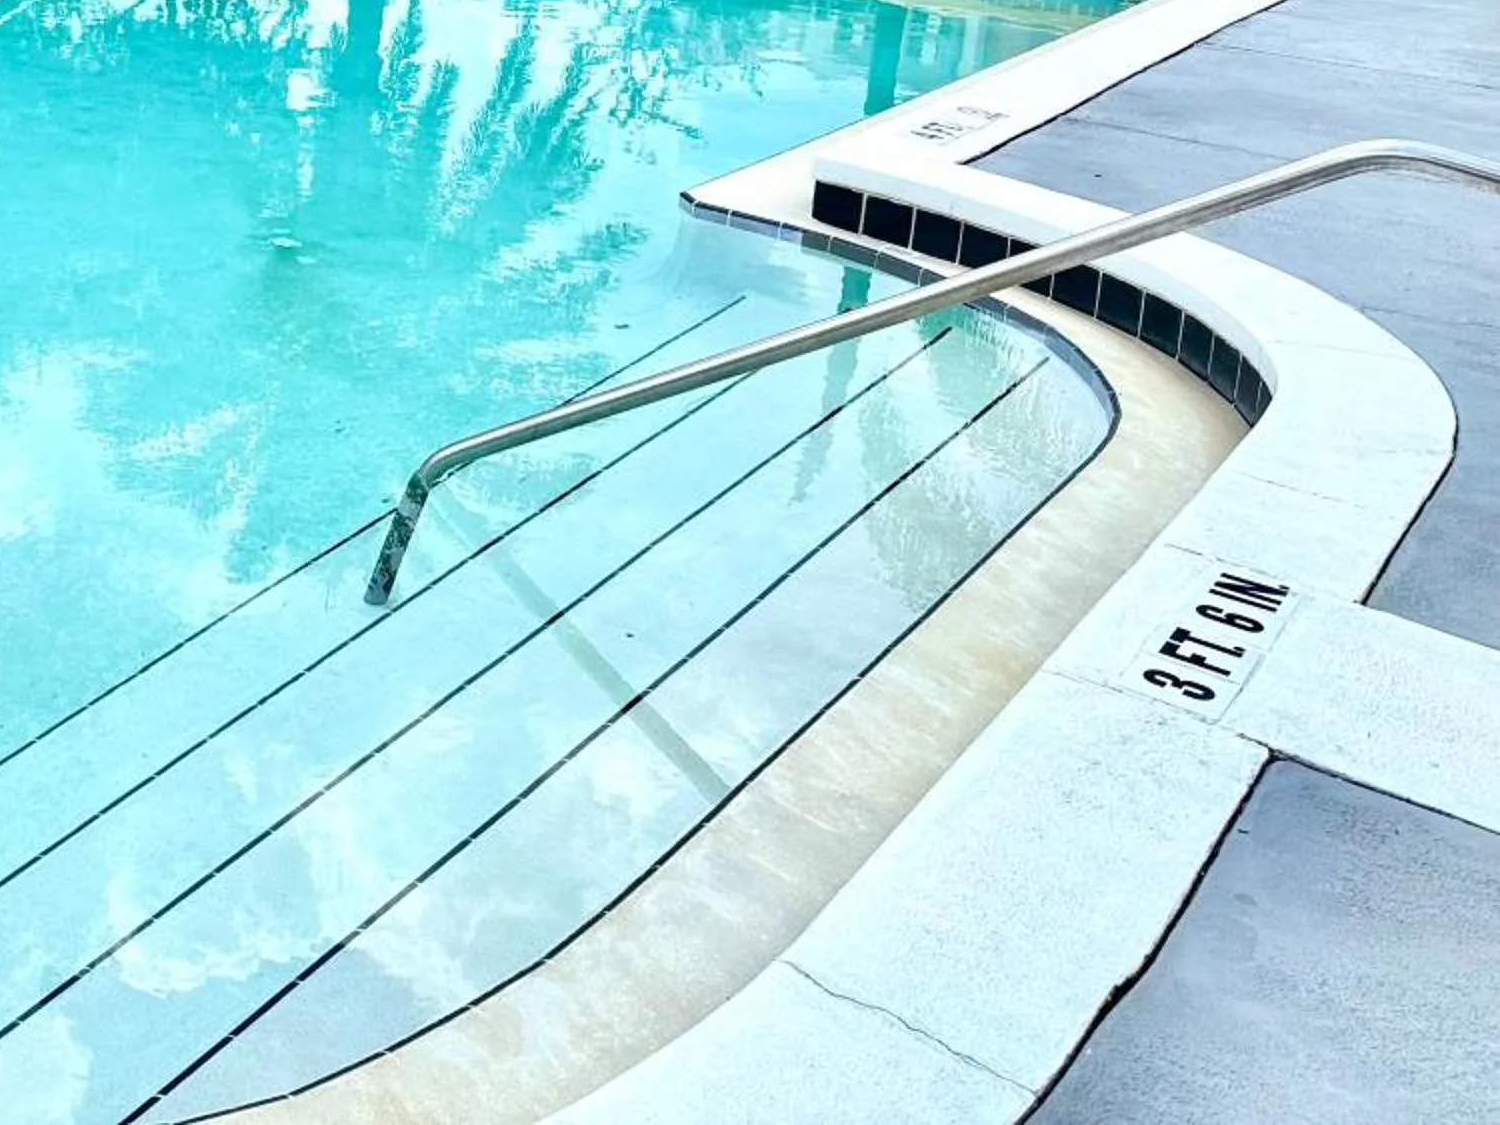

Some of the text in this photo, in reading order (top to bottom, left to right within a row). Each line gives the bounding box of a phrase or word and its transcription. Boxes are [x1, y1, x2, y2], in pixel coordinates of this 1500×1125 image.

[1142, 572, 1290, 701] 3 FT. 6 IN.
